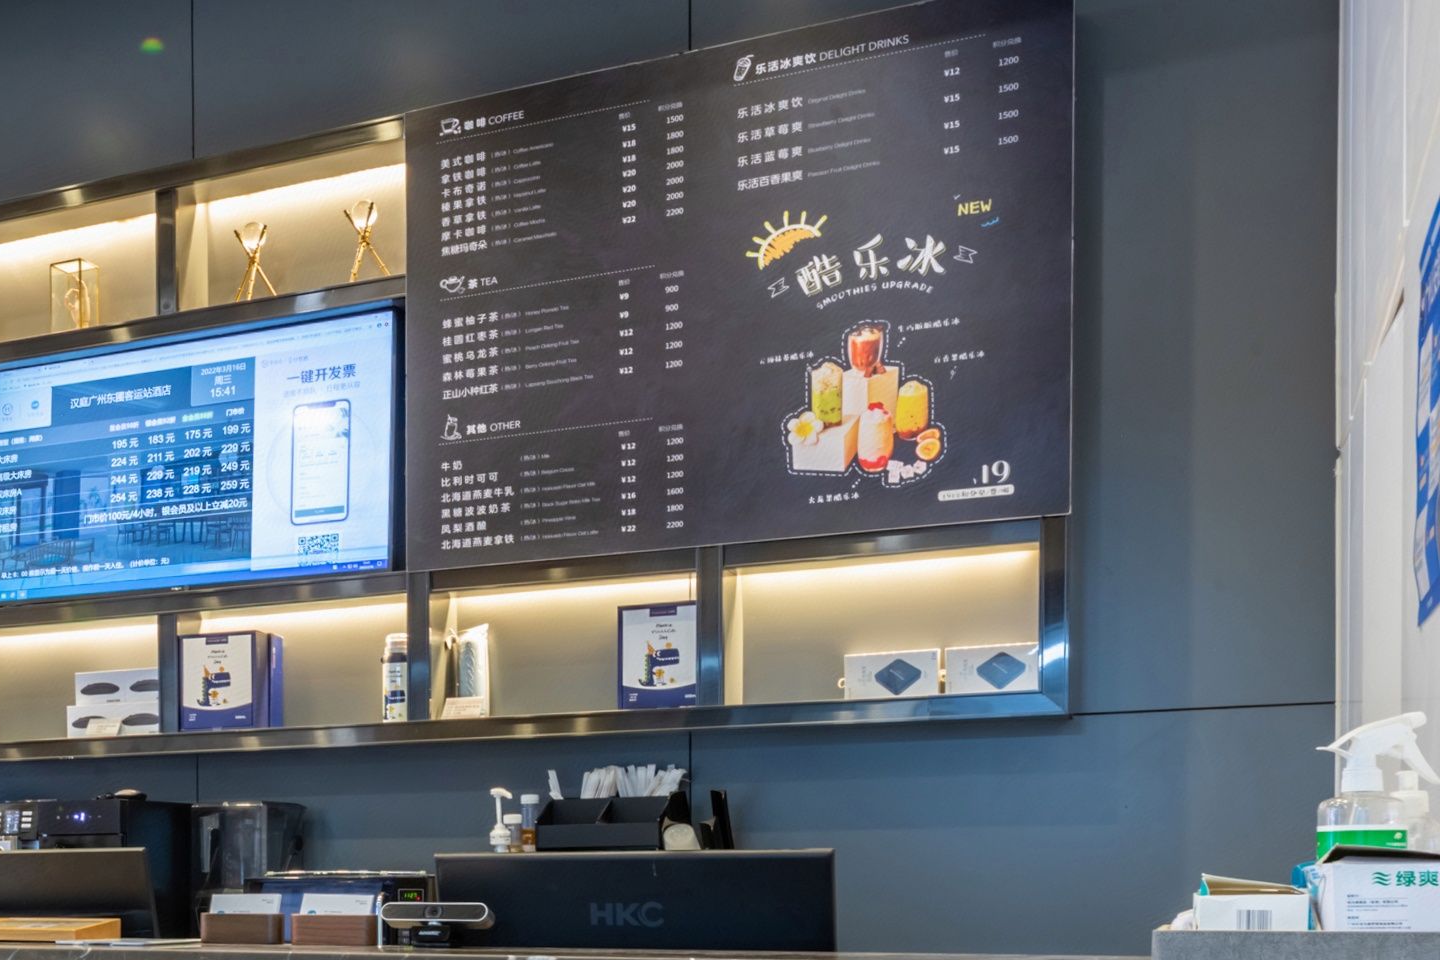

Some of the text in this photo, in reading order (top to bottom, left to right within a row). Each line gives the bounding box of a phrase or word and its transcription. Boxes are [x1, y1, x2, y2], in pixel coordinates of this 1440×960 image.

[755, 34, 910, 75] 乐活冰爽饮 DELIGHT DRINKS
[998, 56, 1019, 67] 1200
[998, 82, 1019, 94] 1500
[737, 96, 803, 119] 乐活冰爽饮
[464, 110, 525, 130] 咖啡 COFFEE
[666, 114, 684, 124] 1500
[998, 109, 1019, 120] 1500
[666, 130, 684, 140] 1800
[737, 121, 803, 144] 乐活草莓爽
[998, 135, 1019, 146] 1500
[666, 145, 684, 155] 1800
[441, 151, 486, 170] 美式咖啡
[737, 146, 803, 168] 乐活蓝莓爽
[666, 160, 684, 170] 2000
[441, 167, 486, 184] 拿铁咖啡
[666, 175, 684, 186] 2000
[441, 181, 486, 198] 卡布奇诺
[666, 191, 684, 201] 2000
[666, 207, 684, 217] 2200
[957, 198, 992, 216] NEW
[795, 233, 947, 297] 酷乐冰
[467, 276, 498, 289] 茶 TEA
[665, 284, 680, 294] 900
[816, 281, 934, 310] SMOOTHIES UPGRADE
[665, 303, 679, 312] 900
[442, 312, 499, 329] 蜂蜜柚子茶
[665, 321, 683, 331] 1200
[442, 329, 499, 347] 桂圆红枣茶
[665, 340, 683, 350] 1200
[442, 347, 499, 365] 蜜桃乌龙茶
[665, 359, 683, 369] 1200
[287, 363, 357, 383] 一键开发票
[442, 365, 499, 383] 森林莓果茶
[214, 374, 232, 386] 周三
[210, 385, 236, 398] 15:41
[442, 383, 499, 400] 正山小种红茶
[466, 420, 521, 435] 其他 OTHER
[666, 437, 684, 446] 1200
[666, 454, 684, 463] 1200
[441, 460, 463, 472] 牛奶
[441, 472, 499, 488] 比利时可可
[666, 470, 684, 479] 1200
[441, 486, 515, 503] 北海道燕麦牛乳
[666, 487, 684, 496] 1600
[441, 502, 511, 519] 黑糖波波奶茶
[666, 504, 684, 512] 1800
[666, 520, 684, 529] 2200
[441, 533, 515, 550] 北海道燕麦拿铁
[1395, 870, 1439, 887] 绿爽
[590, 901, 664, 928] HKC
